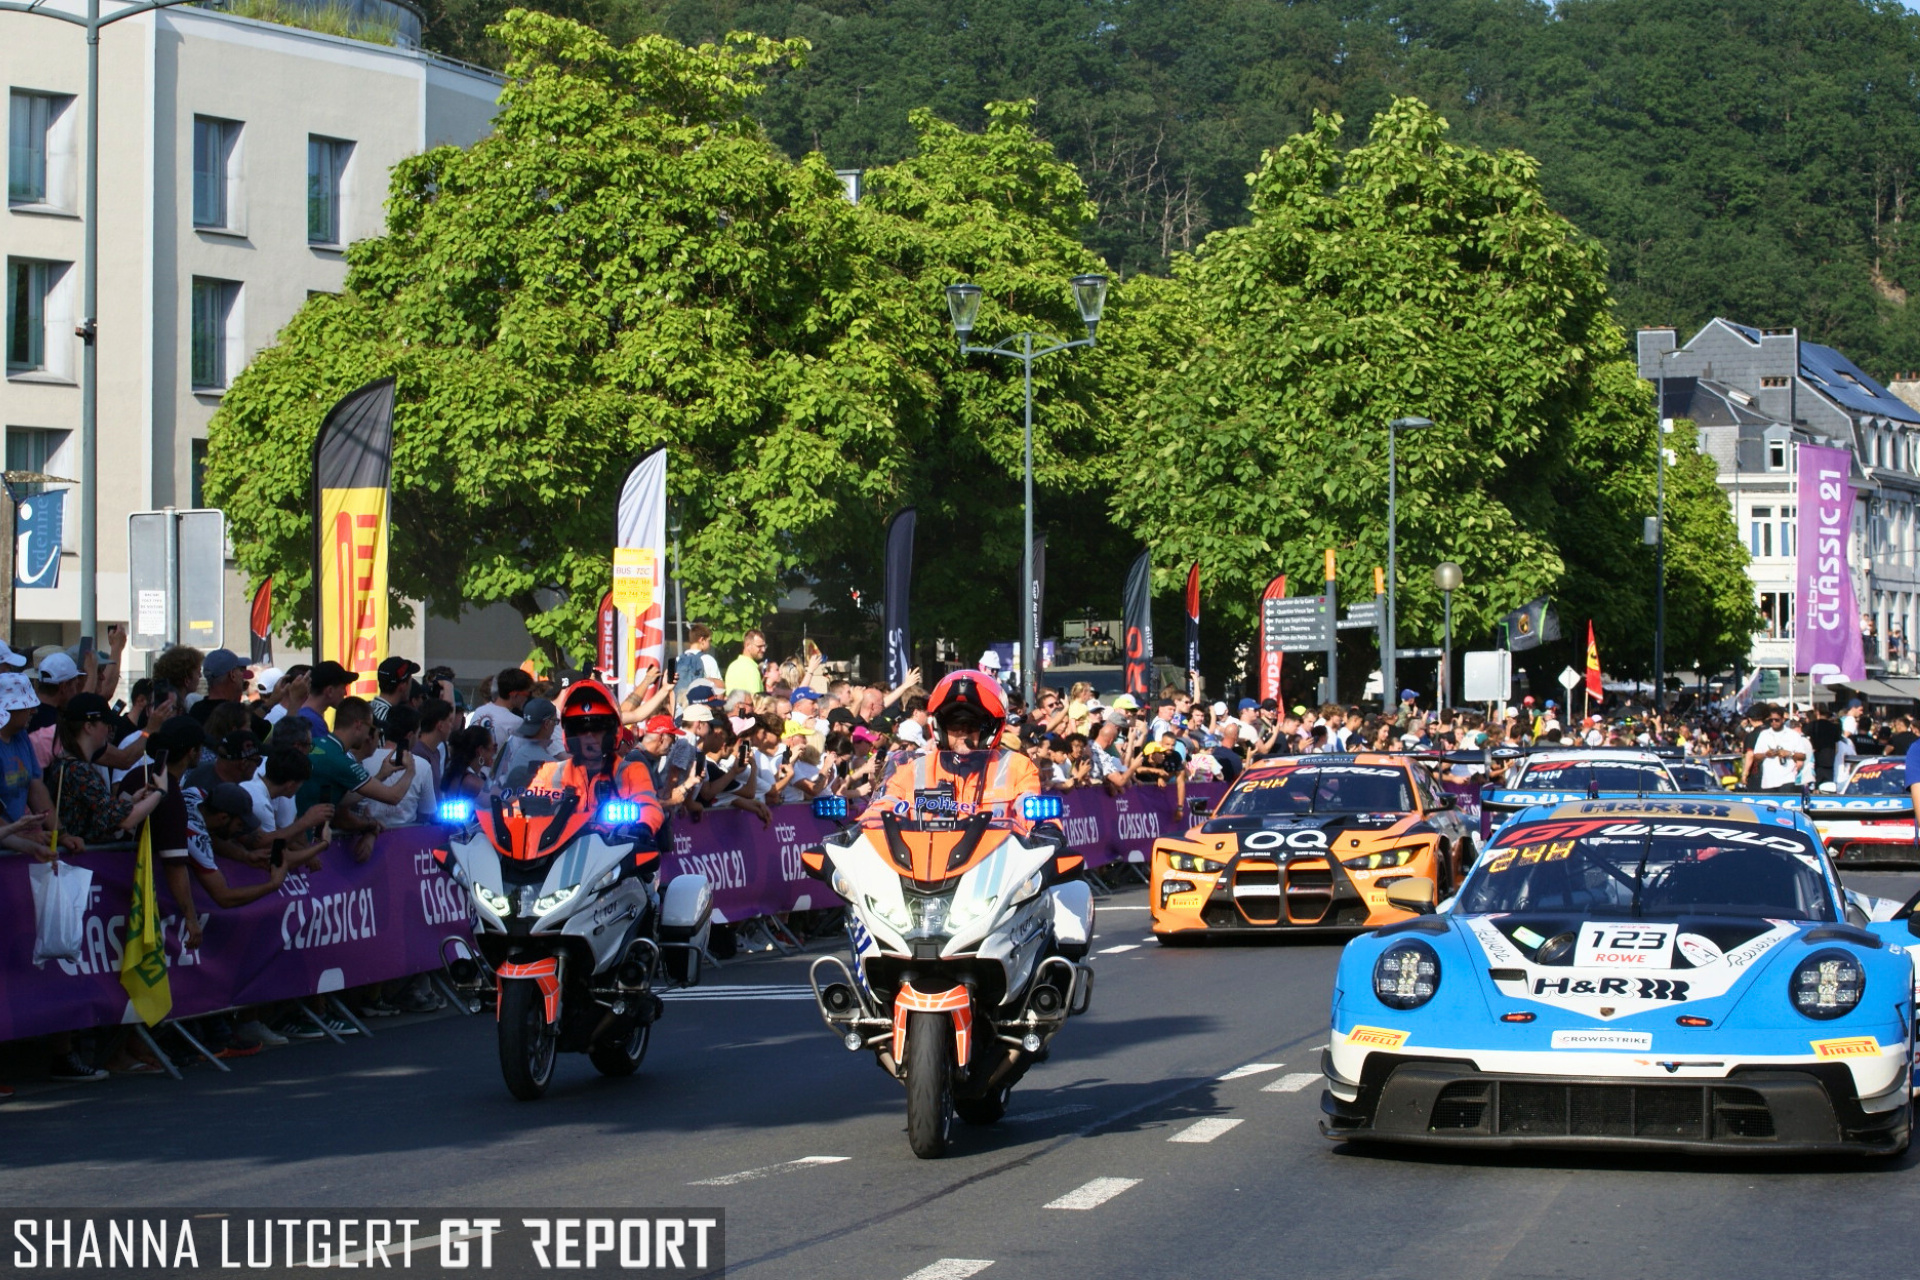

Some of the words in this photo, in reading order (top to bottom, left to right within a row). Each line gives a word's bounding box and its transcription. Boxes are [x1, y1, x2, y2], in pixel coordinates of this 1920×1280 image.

[1819, 469, 1841, 502] 21
[616, 567, 631, 575] BUS
[1818, 507, 1841, 631] CLASSIC
[516, 786, 567, 801] Polizei
[1243, 777, 1288, 793] 24H
[915, 796, 978, 814] Polizei
[1118, 813, 1151, 841] CLASSIC
[1150, 812, 1160, 838] 21
[1244, 830, 1329, 849] OQ
[1600, 824, 1806, 852] WORLD
[1489, 840, 1576, 874] 24H
[281, 891, 359, 950] CLASSIC
[358, 887, 377, 938] 21
[1592, 930, 1668, 950] 123
[1595, 953, 1646, 963] ROWE
[1534, 977, 1629, 995] H&R
[1351, 1029, 1402, 1046] PIRELLI
[1562, 1036, 1648, 1044] CROWDSTRIKE
[1818, 1040, 1876, 1056] PIRELLI
